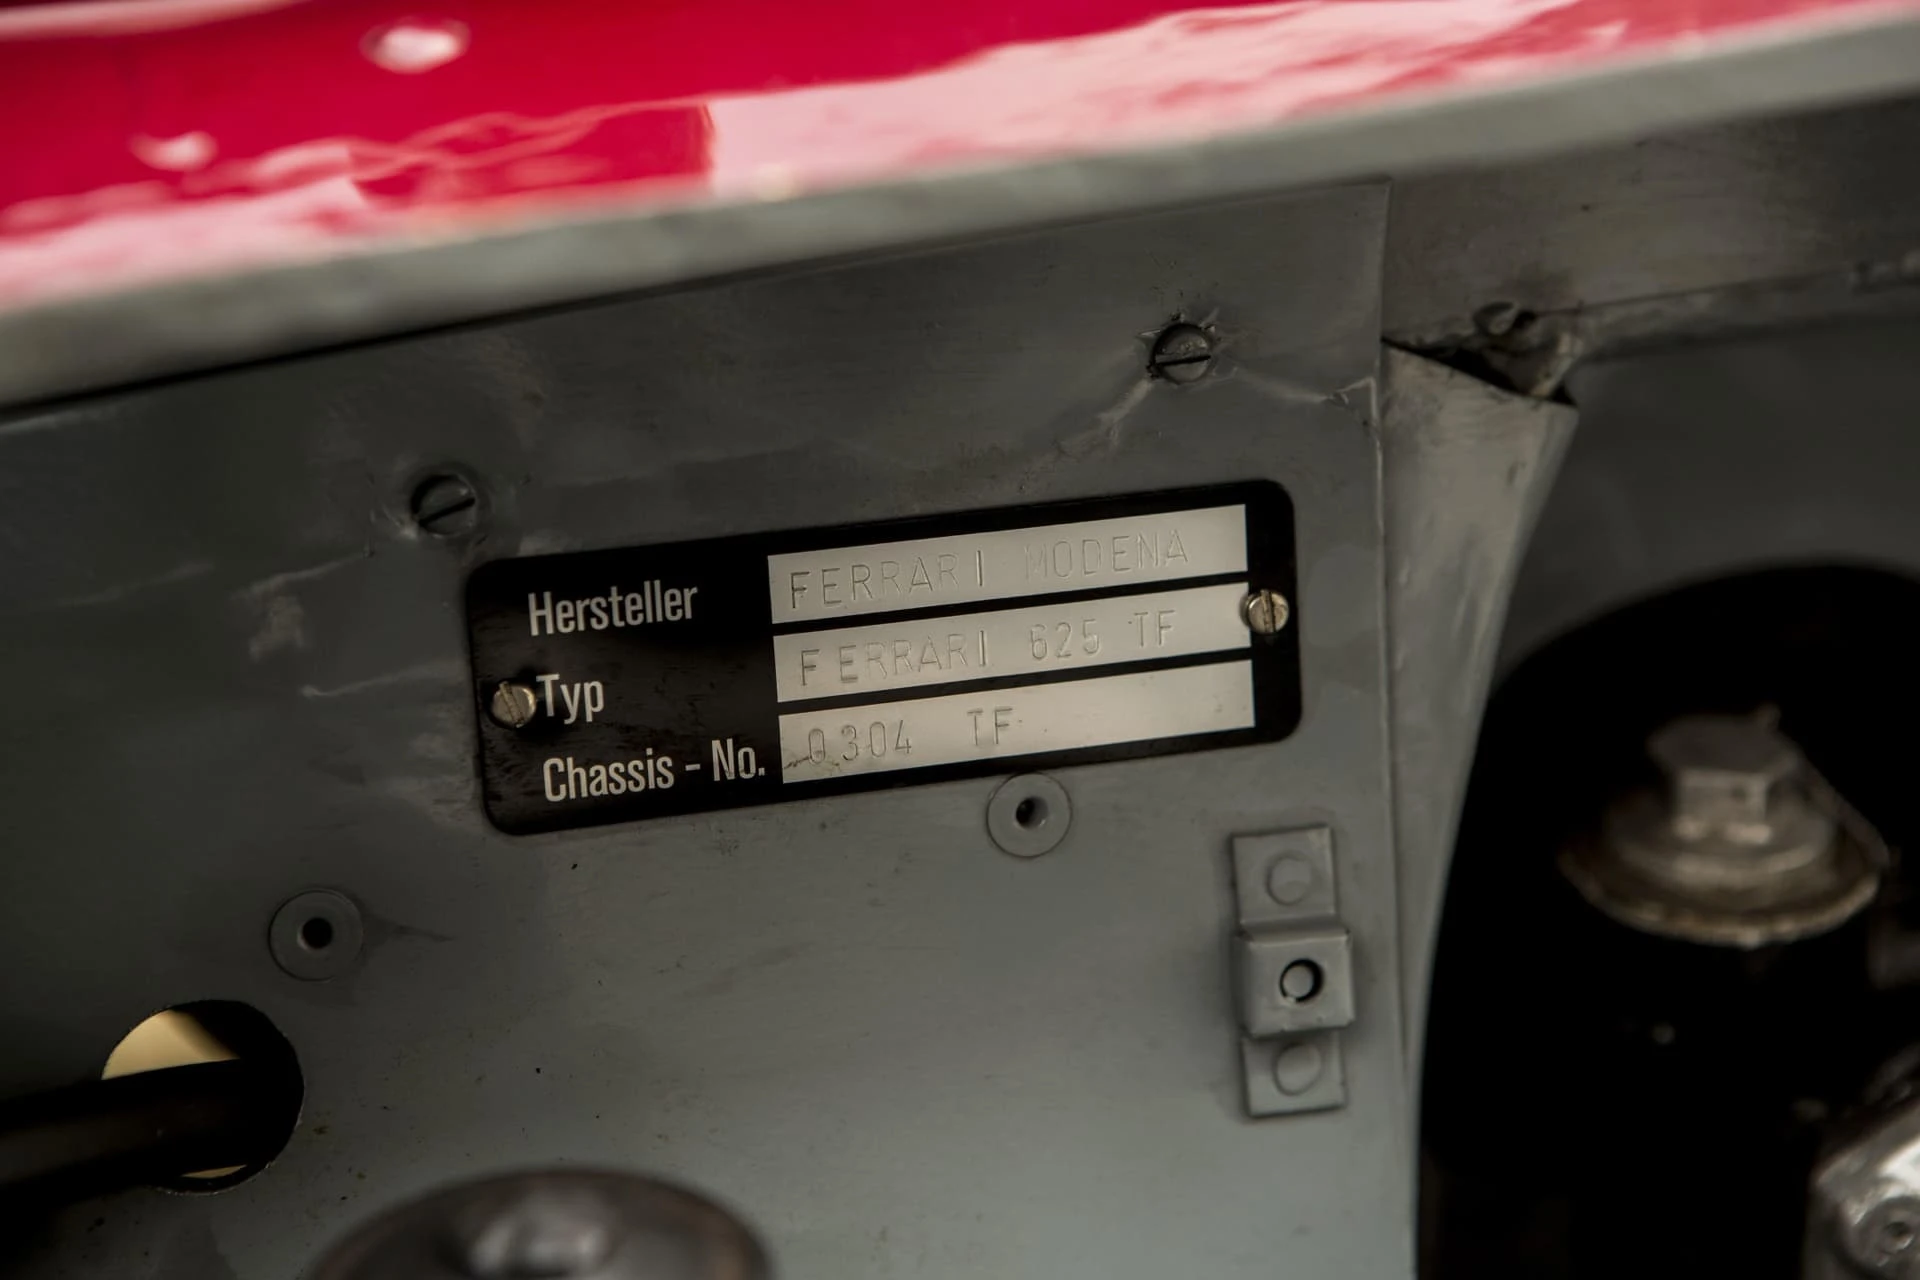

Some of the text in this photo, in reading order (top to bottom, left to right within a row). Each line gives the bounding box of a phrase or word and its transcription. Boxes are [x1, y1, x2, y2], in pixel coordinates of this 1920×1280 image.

[790, 529, 1188, 609] FERRARI MODENA
[528, 579, 698, 636] Hersteller
[801, 609, 1176, 686] FERRARI 625 TF
[536, 673, 605, 725] Typ
[967, 706, 1013, 746] TF
[543, 747, 675, 802] Chassis
[711, 737, 766, 782] No.
